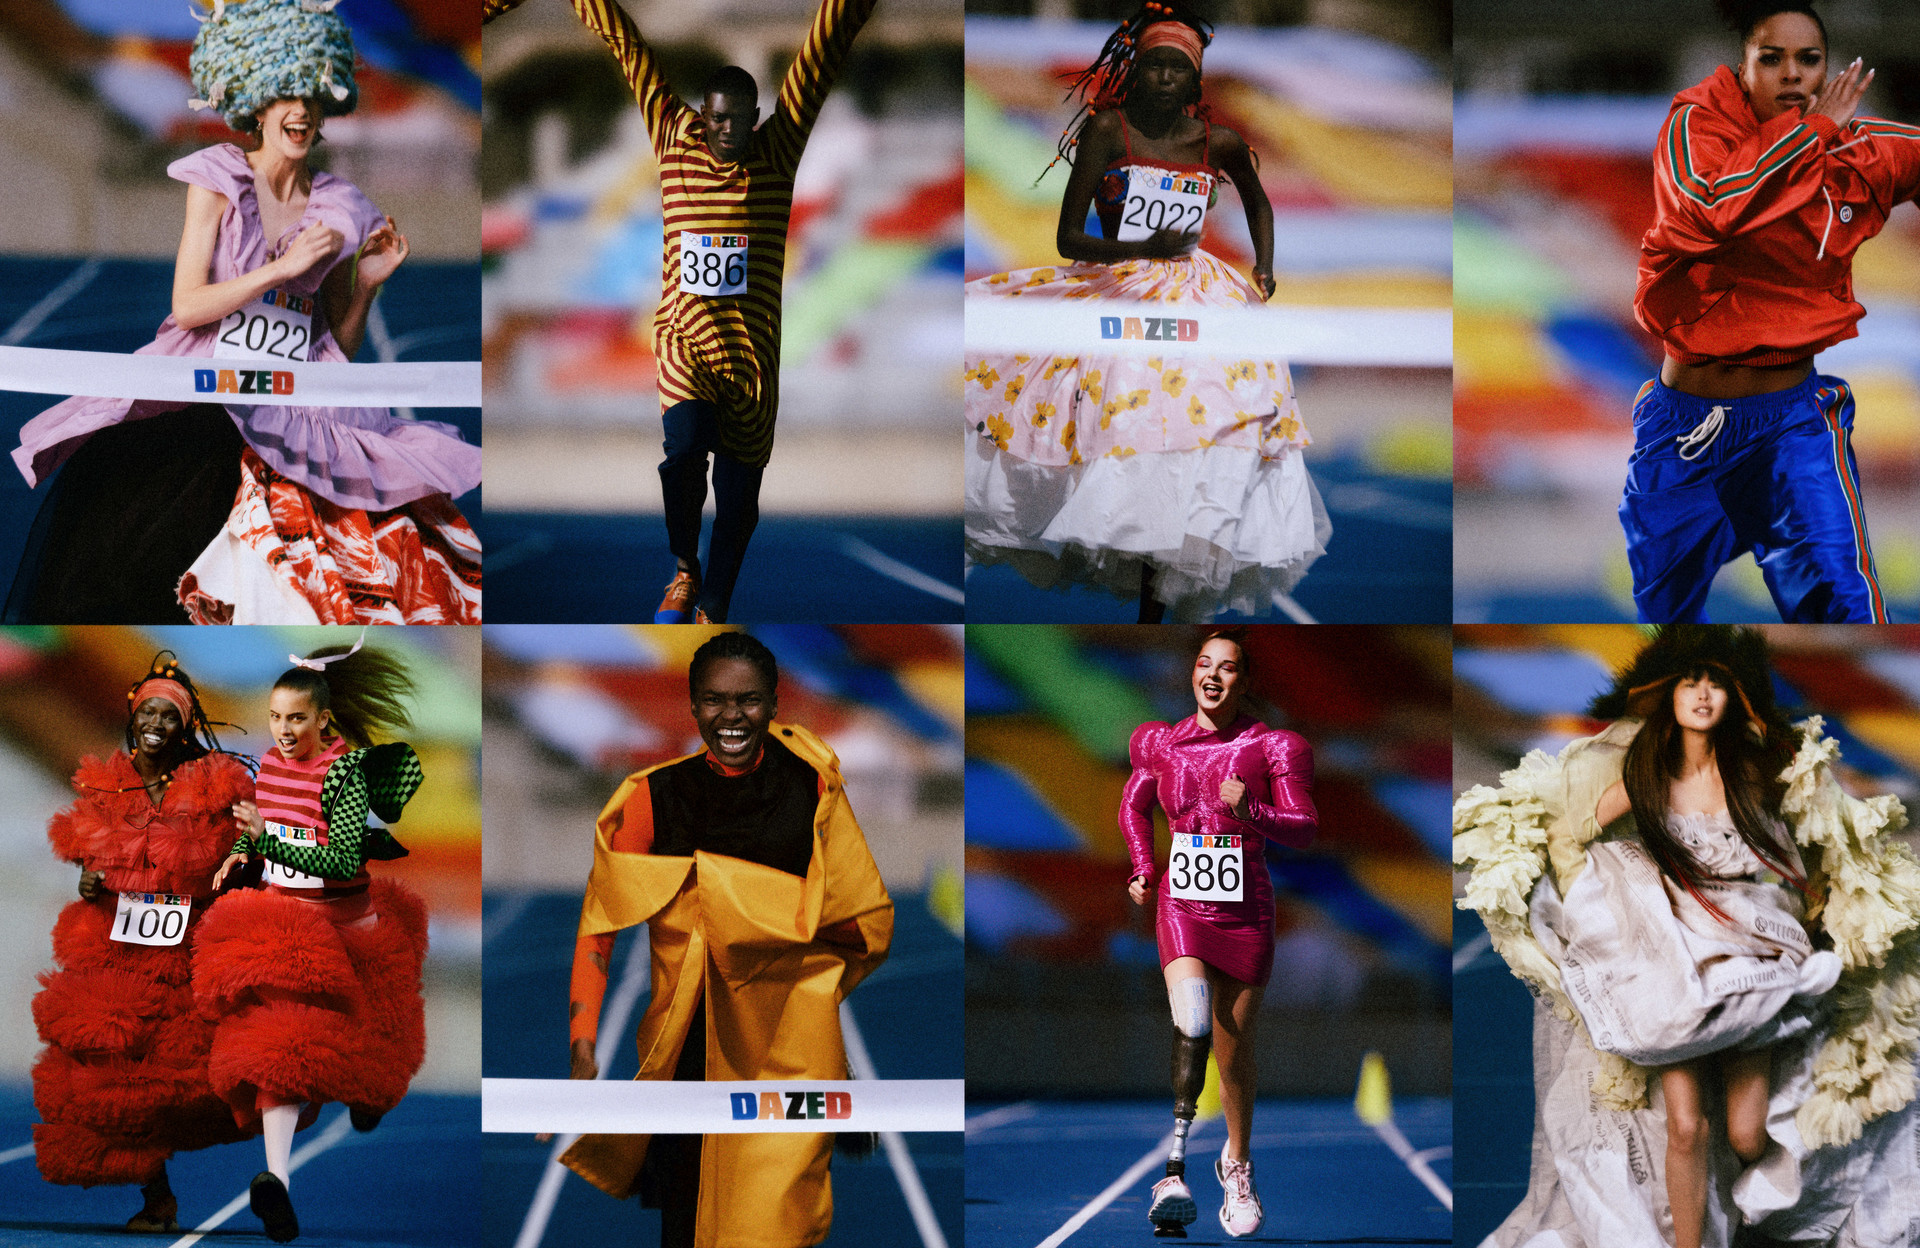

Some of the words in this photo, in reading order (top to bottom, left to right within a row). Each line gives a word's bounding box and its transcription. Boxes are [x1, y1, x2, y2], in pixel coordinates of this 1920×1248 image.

[1160, 176, 1209, 196] DAZED
[1124, 195, 1203, 234] 2022
[702, 235, 747, 248] DAZED
[683, 250, 745, 287] 386
[262, 289, 314, 317] DAZED
[220, 309, 308, 362] 2022
[1100, 316, 1199, 342] DAZED
[194, 369, 294, 395] DAZED
[280, 825, 315, 841] DAZED
[1192, 835, 1241, 848] DAZED
[1172, 852, 1240, 892] 386
[144, 893, 191, 906] DAZED
[119, 907, 183, 939] 100
[730, 1091, 852, 1120] DAZED
